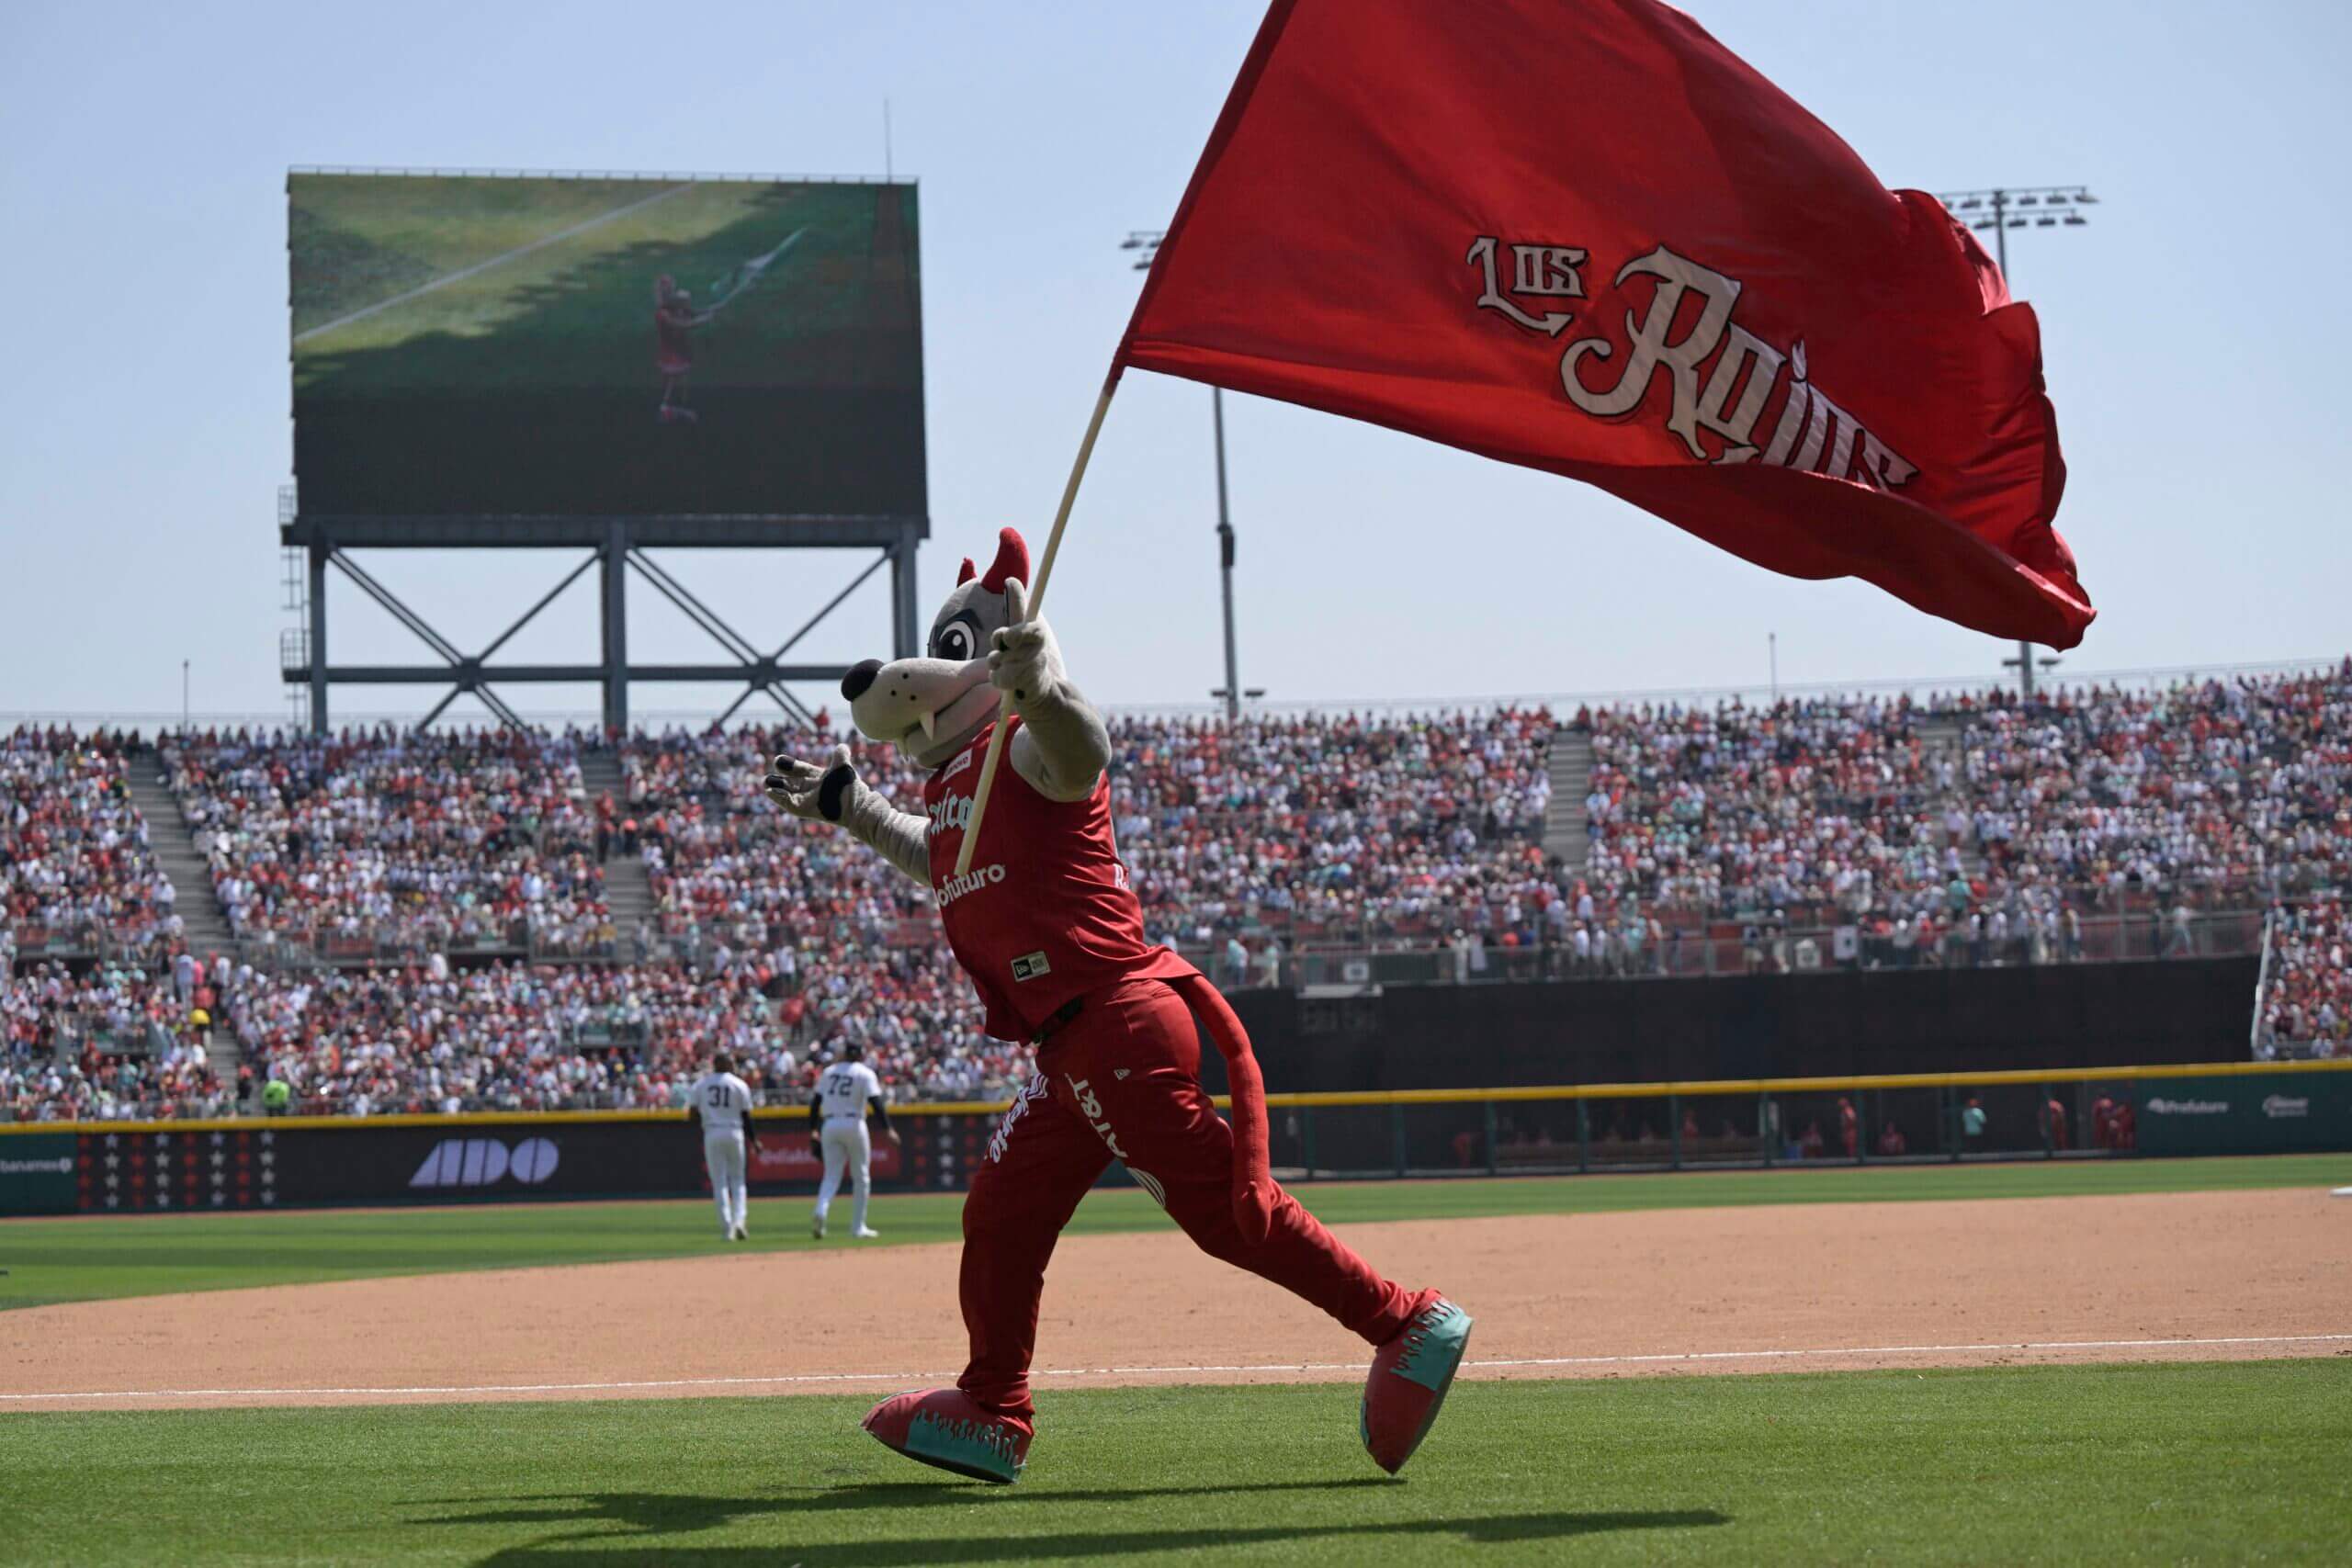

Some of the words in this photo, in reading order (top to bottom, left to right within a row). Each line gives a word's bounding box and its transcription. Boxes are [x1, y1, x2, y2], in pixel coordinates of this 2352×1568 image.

[827, 1074, 854, 1097] 72
[707, 1086, 730, 1109] 31
[409, 1137, 560, 1188] ADO
